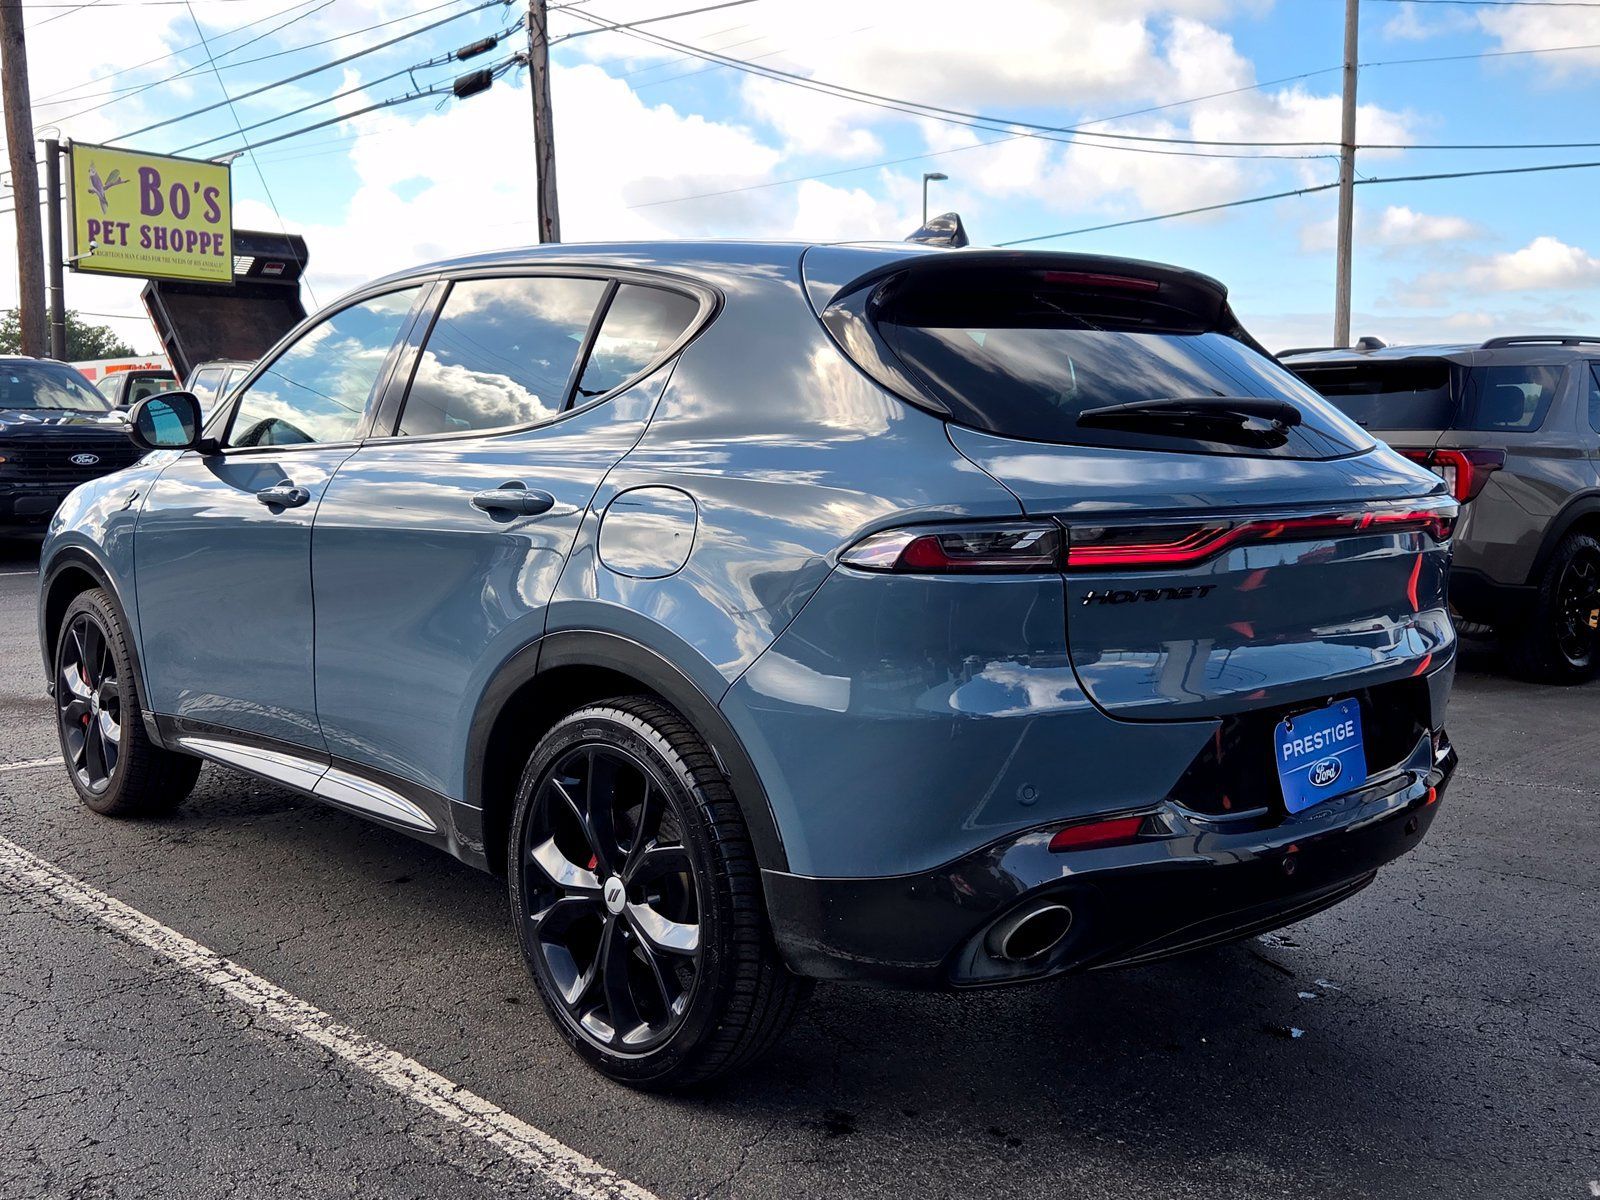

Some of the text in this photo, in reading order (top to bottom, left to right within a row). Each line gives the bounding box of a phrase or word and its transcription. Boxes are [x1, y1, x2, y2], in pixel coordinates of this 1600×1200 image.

[87, 218, 225, 257] PET SHOPPE
[1081, 584, 1218, 605] HORNET
[1282, 720, 1354, 761] PRESTIGE
